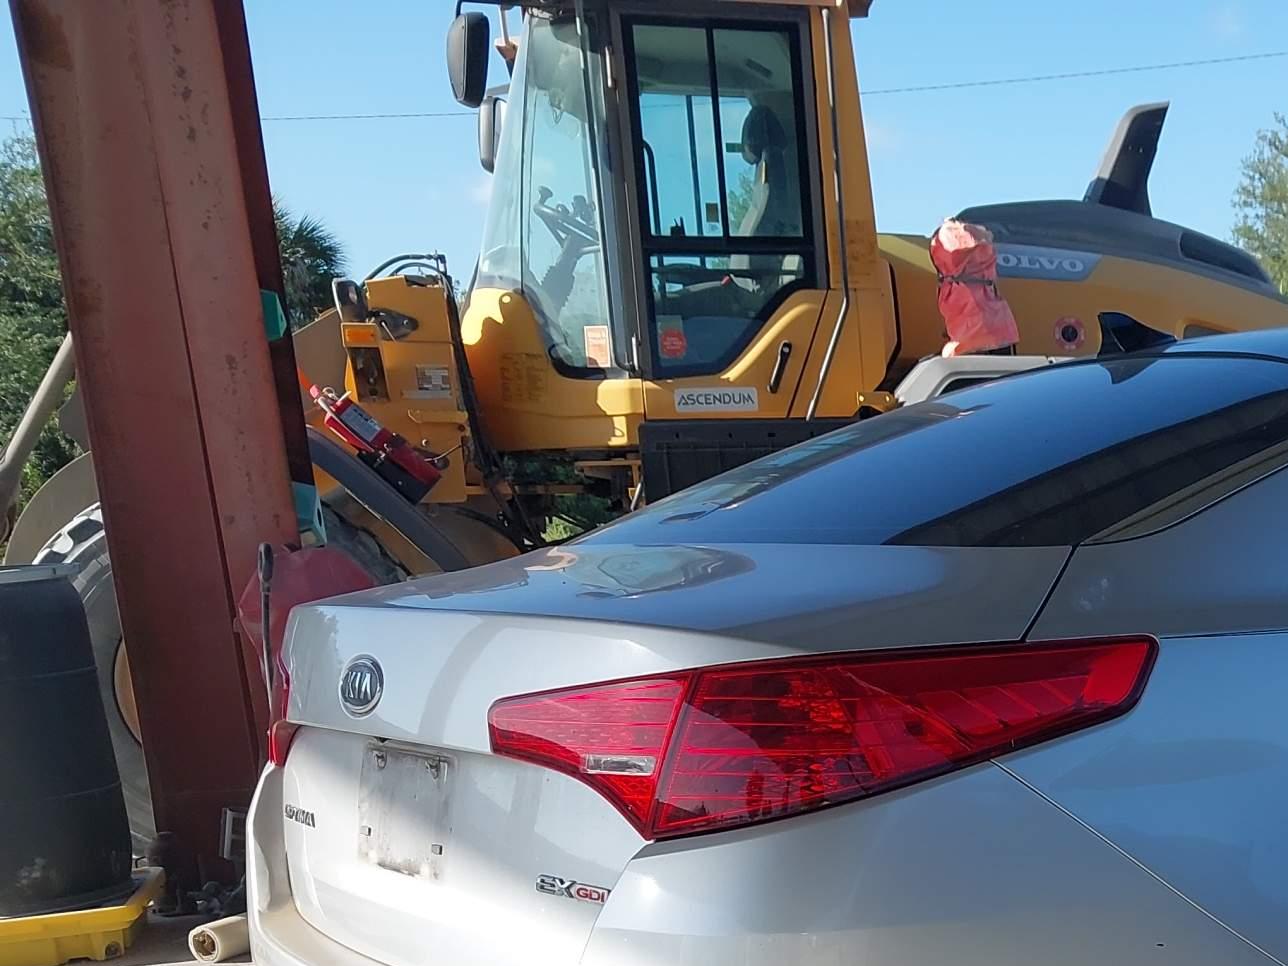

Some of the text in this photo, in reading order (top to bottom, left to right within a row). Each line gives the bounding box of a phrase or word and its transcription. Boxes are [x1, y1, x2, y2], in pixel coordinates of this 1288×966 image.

[997, 253, 1084, 273] OLVO
[677, 392, 755, 406] ASCENDUM
[345, 671, 372, 701] KIA
[536, 873, 606, 904] EX GDI
